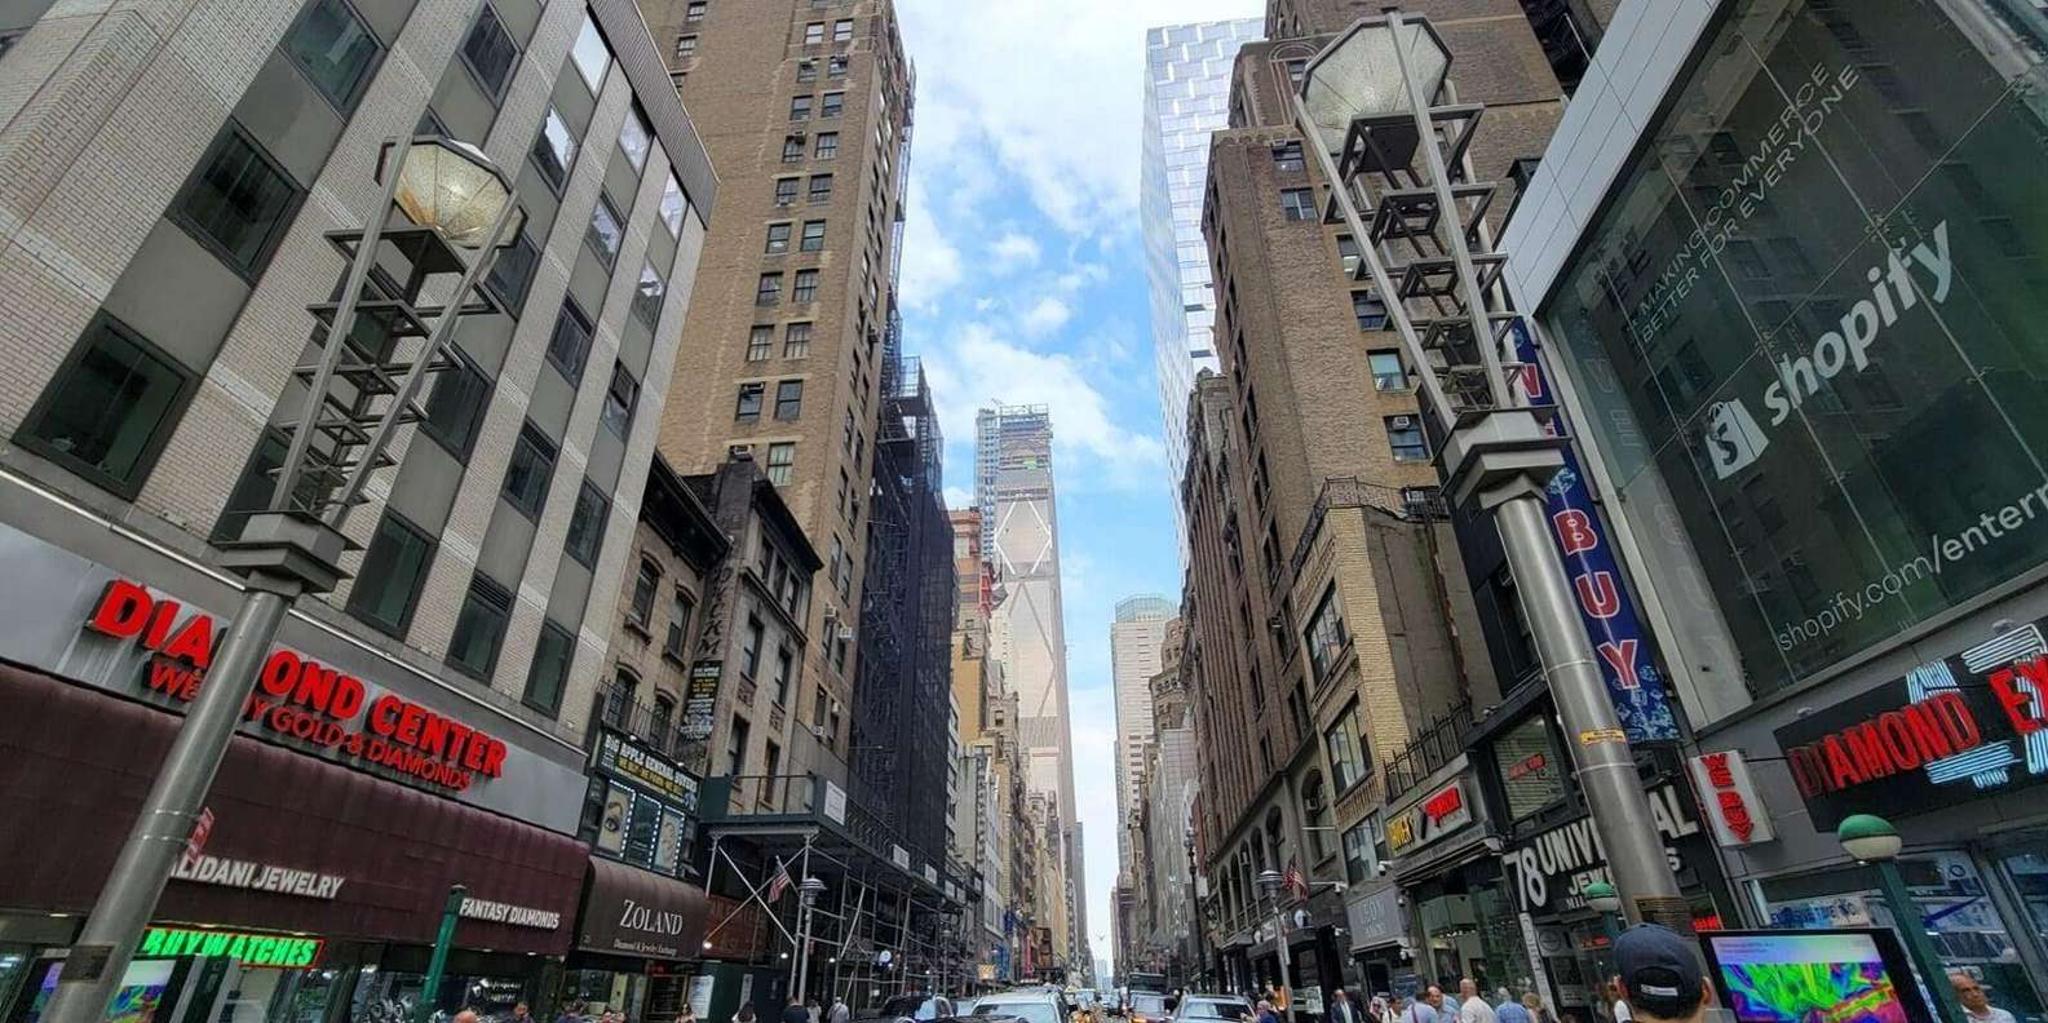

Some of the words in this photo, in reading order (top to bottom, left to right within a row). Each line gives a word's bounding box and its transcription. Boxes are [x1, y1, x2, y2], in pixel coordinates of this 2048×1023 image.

[1641, 230, 1706, 314] MAKING
[1705, 62, 1829, 228] COMMERCE
[1641, 267, 1702, 344] BETTER
[1699, 218, 1742, 270] FOR
[1739, 64, 1860, 219] EVERYONE
[1764, 220, 1957, 426] shopify
[1553, 508, 1639, 691] BUY
[90, 579, 367, 720] DIAOND
[370, 693, 508, 778] CENTER
[271, 704, 345, 748] GOLD
[367, 738, 473, 793] DIAMONDS
[1700, 752, 1736, 788] WE
[1788, 691, 1982, 798] DIAMOND
[253, 864, 345, 900] JEWELRY
[1503, 846, 1547, 912] 78
[1535, 784, 1699, 877] UNIVAL
[142, 927, 204, 957] BUY
[203, 933, 319, 967] WATCHES
[459, 897, 511, 922] FANTASY
[507, 905, 561, 930] DIAMONDS
[619, 898, 684, 937] ZOLAND
